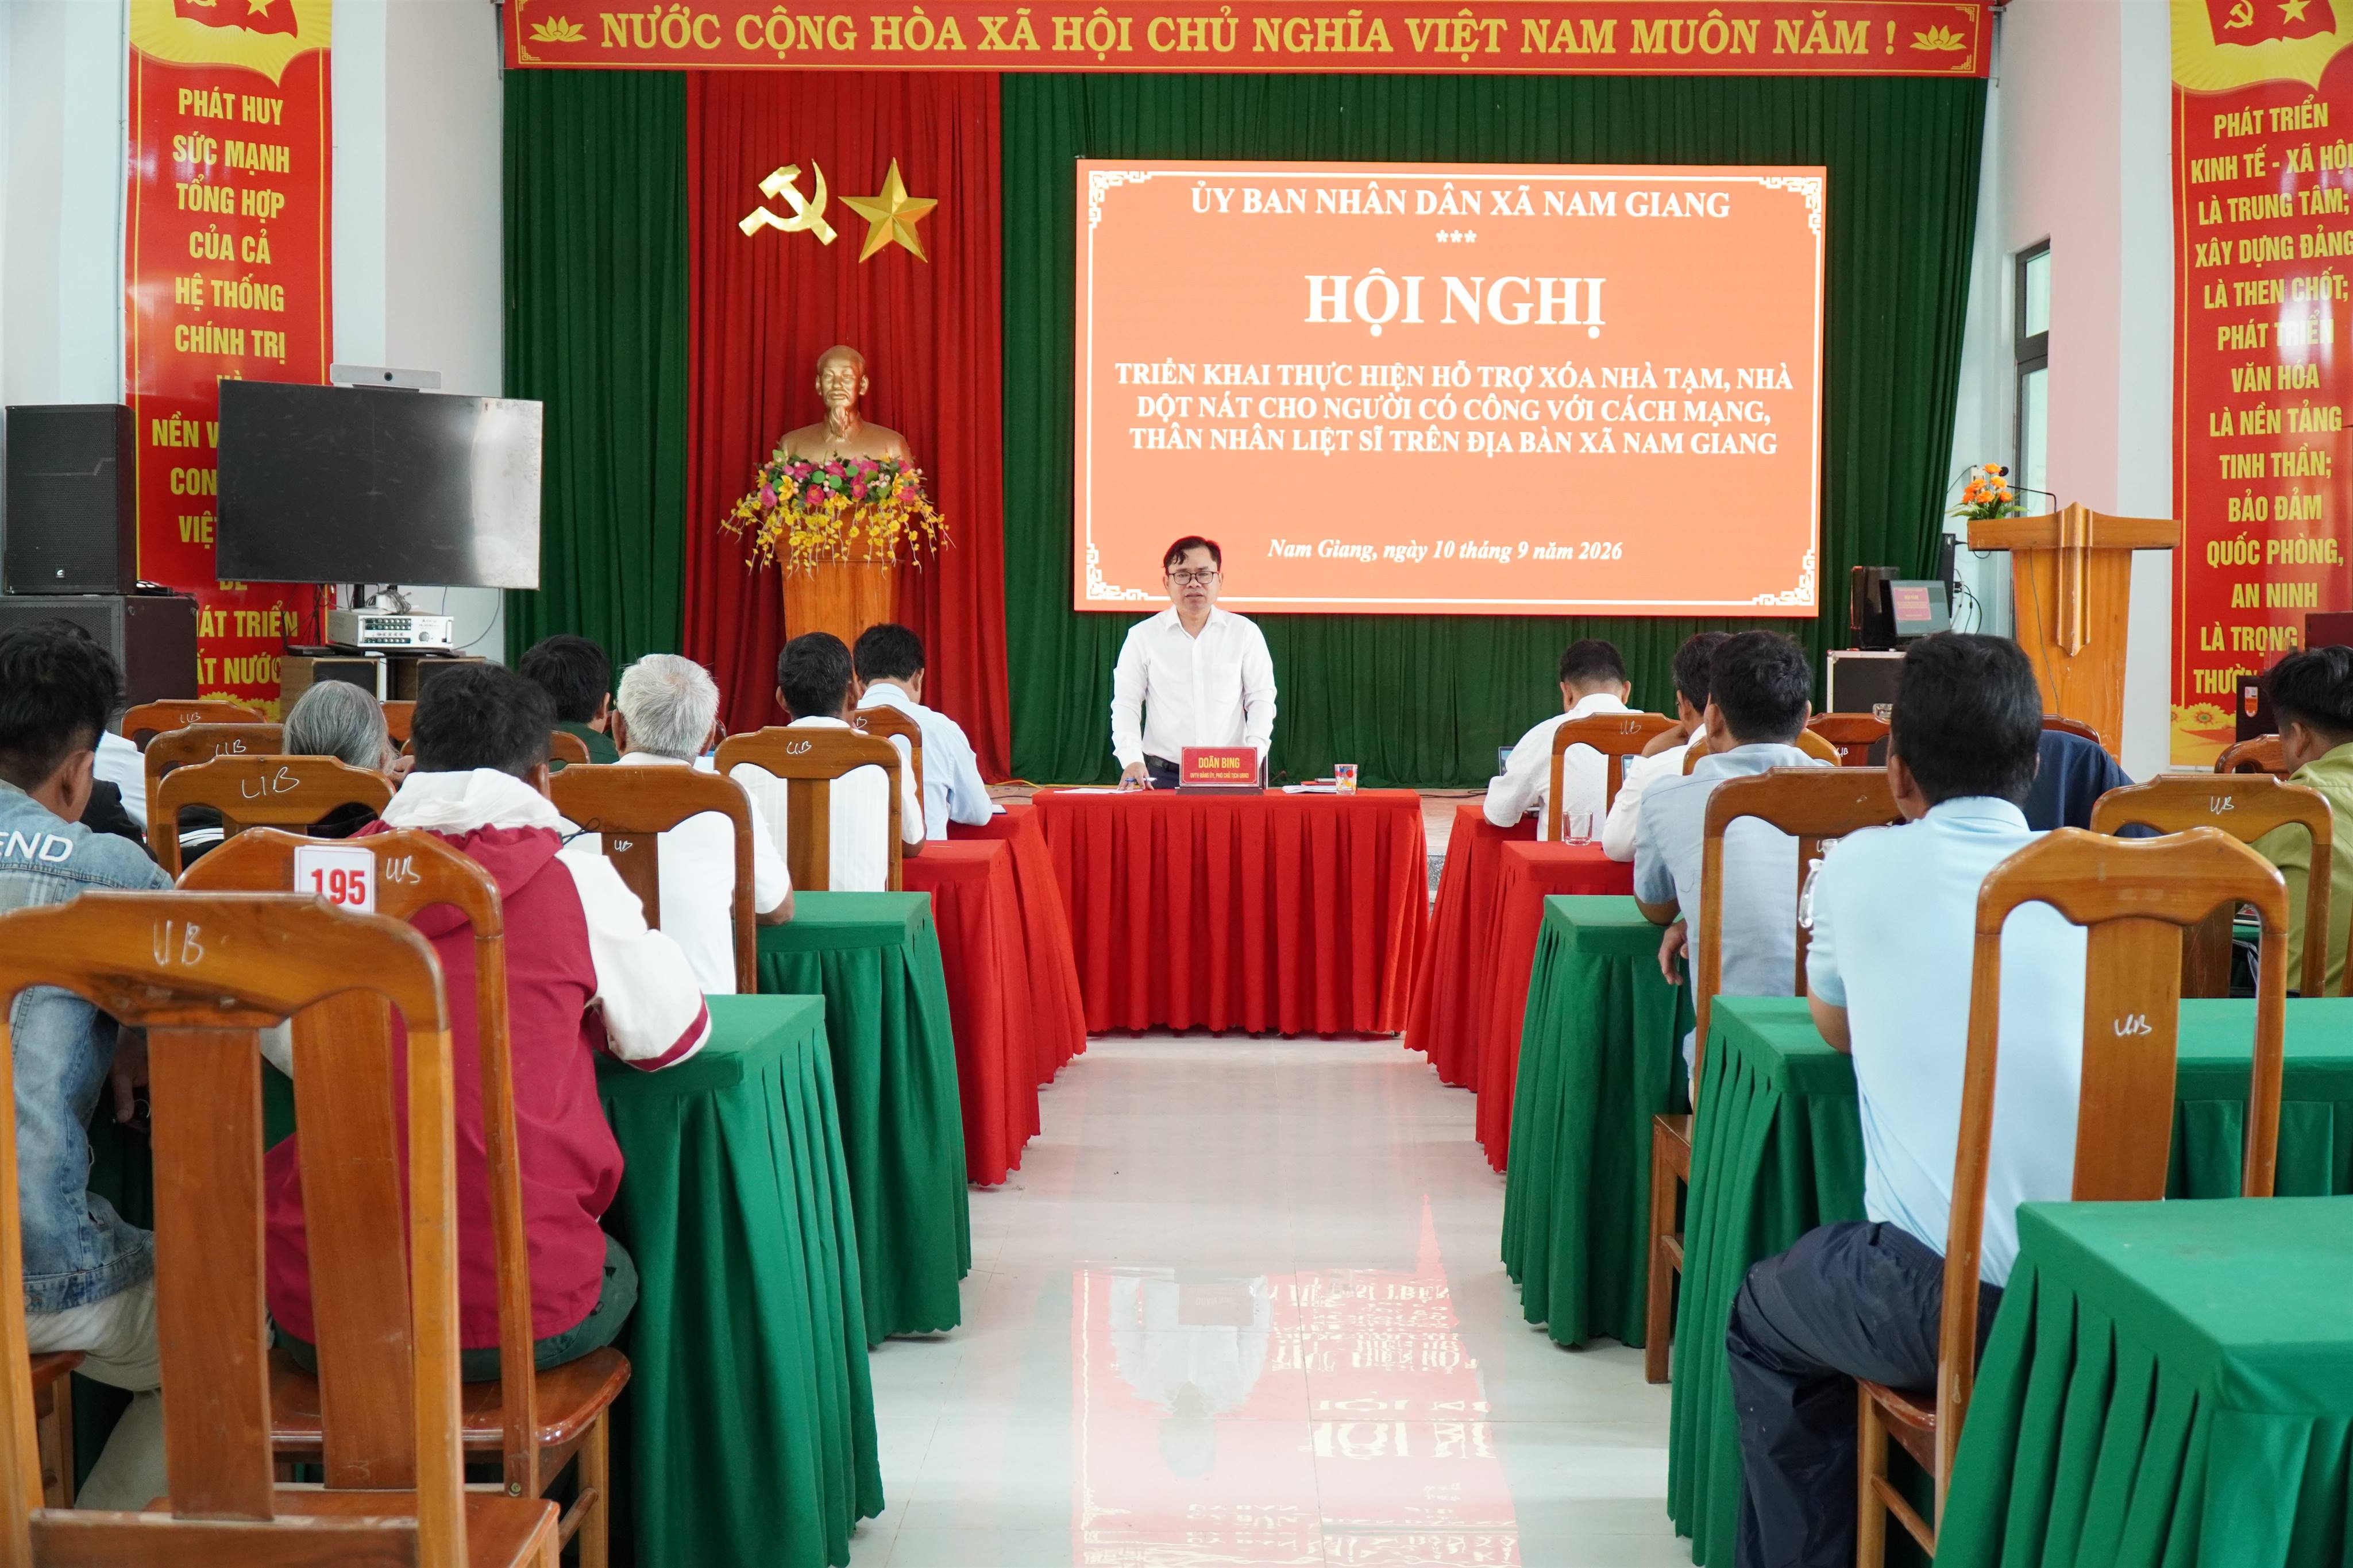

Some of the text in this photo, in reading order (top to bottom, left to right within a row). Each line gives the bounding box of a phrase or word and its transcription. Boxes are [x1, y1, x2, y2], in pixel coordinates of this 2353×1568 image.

[600, 3, 720, 49] NƯỚC
[736, 5, 857, 59] CỘNG
[870, 6, 966, 51] HÒA
[978, 8, 1040, 50] XÃ
[1052, 7, 1132, 60] HỘI
[1147, 6, 1239, 52] CHỦ
[1253, 9, 1393, 52] NGHĨA
[1405, 9, 1507, 61] VIỆT
[1521, 19, 1617, 53] NAM
[1630, 9, 1760, 54] MUÔN
[1773, 9, 1870, 54] NĂM
[179, 87, 283, 125] PHÁT HUY
[2215, 94, 2328, 138] PHÁT TRIỂN
[173, 132, 289, 175] SỨC MẠNH
[2192, 156, 2238, 183] KINH
[2244, 145, 2266, 177] TẾ
[2287, 144, 2314, 173] XÃ
[176, 174, 284, 223] TỔNG HỢP
[1191, 180, 1730, 218] ỦY BAN NHÂN DÂN XÃ NAM GIANG
[2199, 185, 2349, 225] LÀ TRUNG TÂM;
[190, 224, 271, 264] CỦA CẢ
[2196, 225, 2353, 267] XÂY DỰNG ĐẢNG
[175, 273, 284, 311] HỆ THỐNG
[1305, 268, 1606, 338] HỘI NGHỊ
[2205, 267, 2348, 308] LÀ THEN CHỐT;
[175, 321, 285, 364] CHÍNH TRỊ
[2217, 310, 2334, 350] PHÁT TRIỂN
[1115, 358, 1793, 394] TRIỂN KHAI THỰC HIỆN HỖ TRỢ XÓA NHÀ TẠM, NHÀ
[2232, 359, 2319, 392] VĂN HÓA
[1137, 391, 1770, 427] DỘT NÁT CHO NGƯỜI CÓ CÔNG VỚI CÁCH MẠNG,
[2211, 399, 2342, 437] LÀ NỀN TẢNG
[153, 412, 199, 447] NỀN
[1129, 422, 1777, 458] THÂN NHÂN LIỆT SĨ TRÊN ĐỊA BÀN XÃ NAM GIANG
[2220, 442, 2331, 478] TINH THẦN;
[171, 468, 217, 495] CON
[2229, 487, 2322, 522] BẢO ĐẢM
[179, 510, 217, 549] VIỆ
[1268, 539, 1622, 563] Nam Giang, ngày 10 tháng 9 năm 2026
[2207, 531, 2344, 567] QUỐC PHÒNG,
[2232, 583, 2318, 607] AN NINH
[196, 600, 298, 637] ÁT TRIỂN
[2201, 621, 2297, 656] LÀ TRỌNG
[1221, 758, 1240, 768] BING
[311, 868, 365, 905] 195
